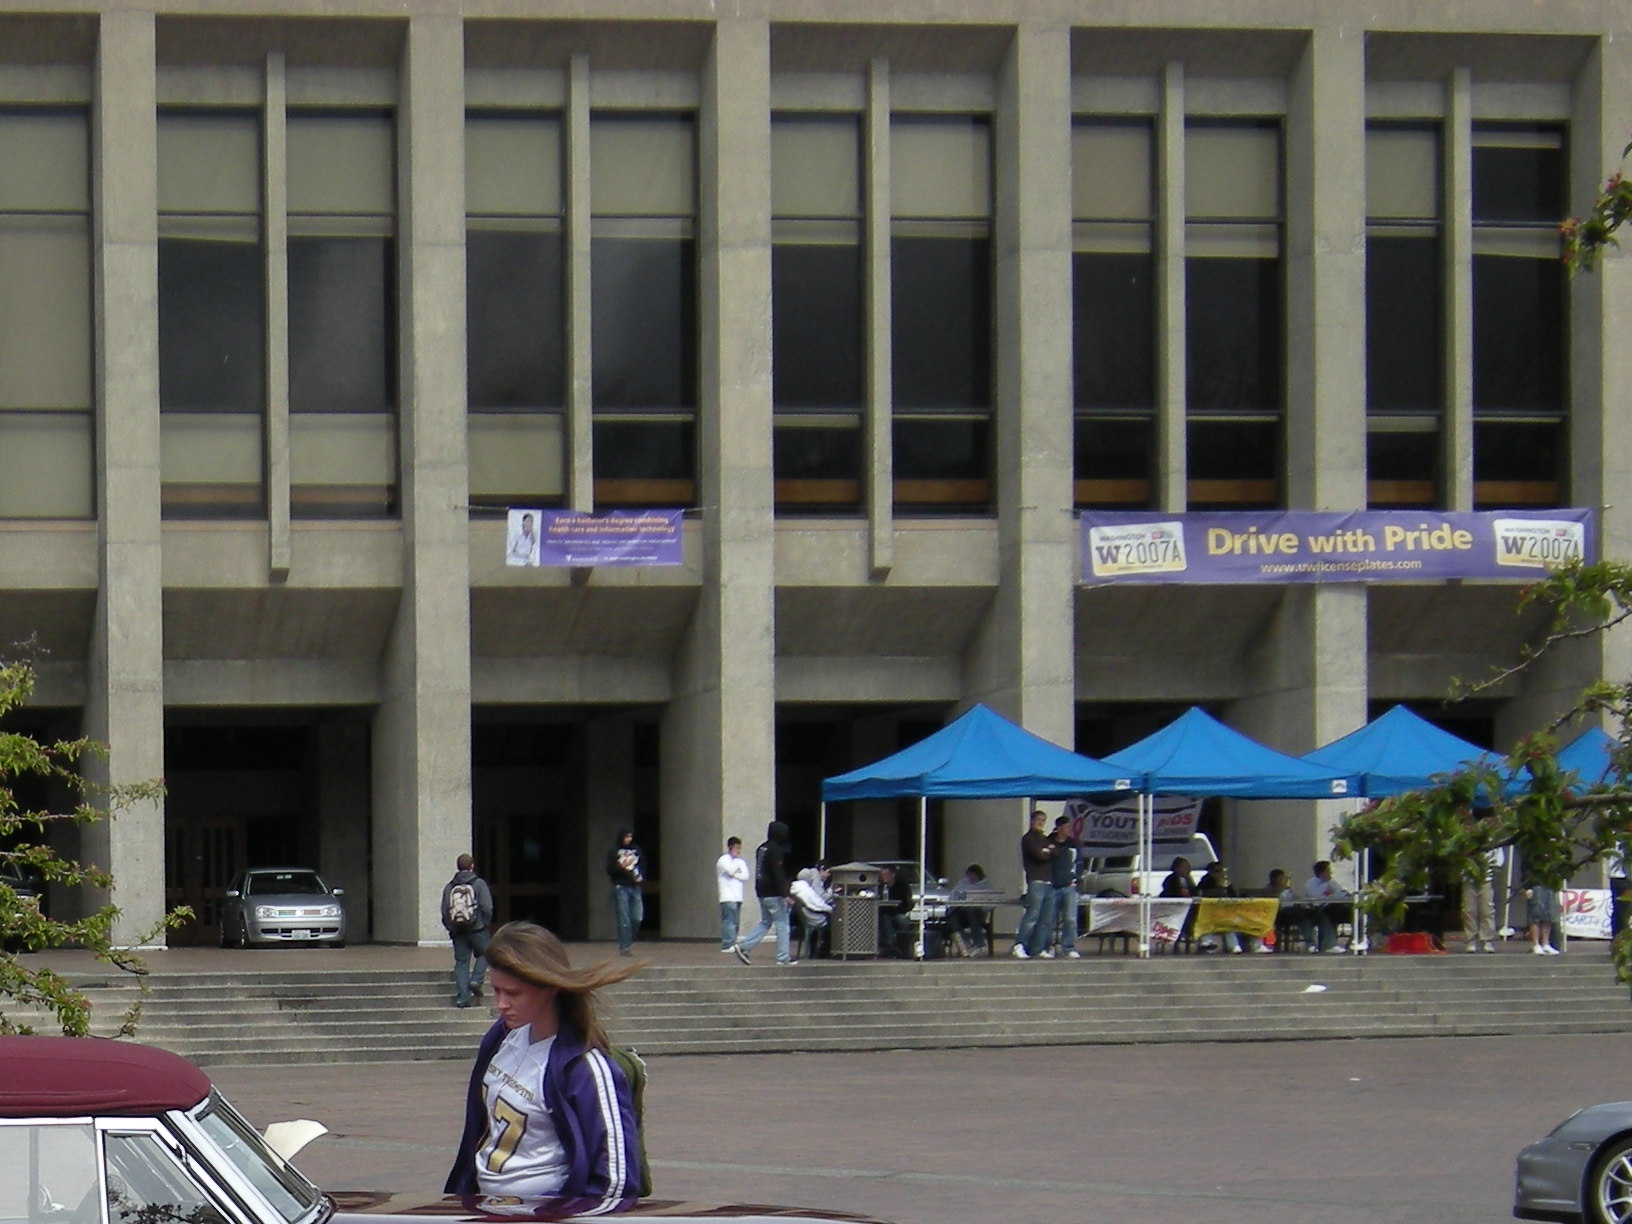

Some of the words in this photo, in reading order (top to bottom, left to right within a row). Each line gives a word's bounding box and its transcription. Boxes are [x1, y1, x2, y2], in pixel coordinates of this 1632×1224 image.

[1208, 526, 1299, 555] Drive
[1308, 529, 1376, 553] with
[1384, 523, 1473, 551] Pride
